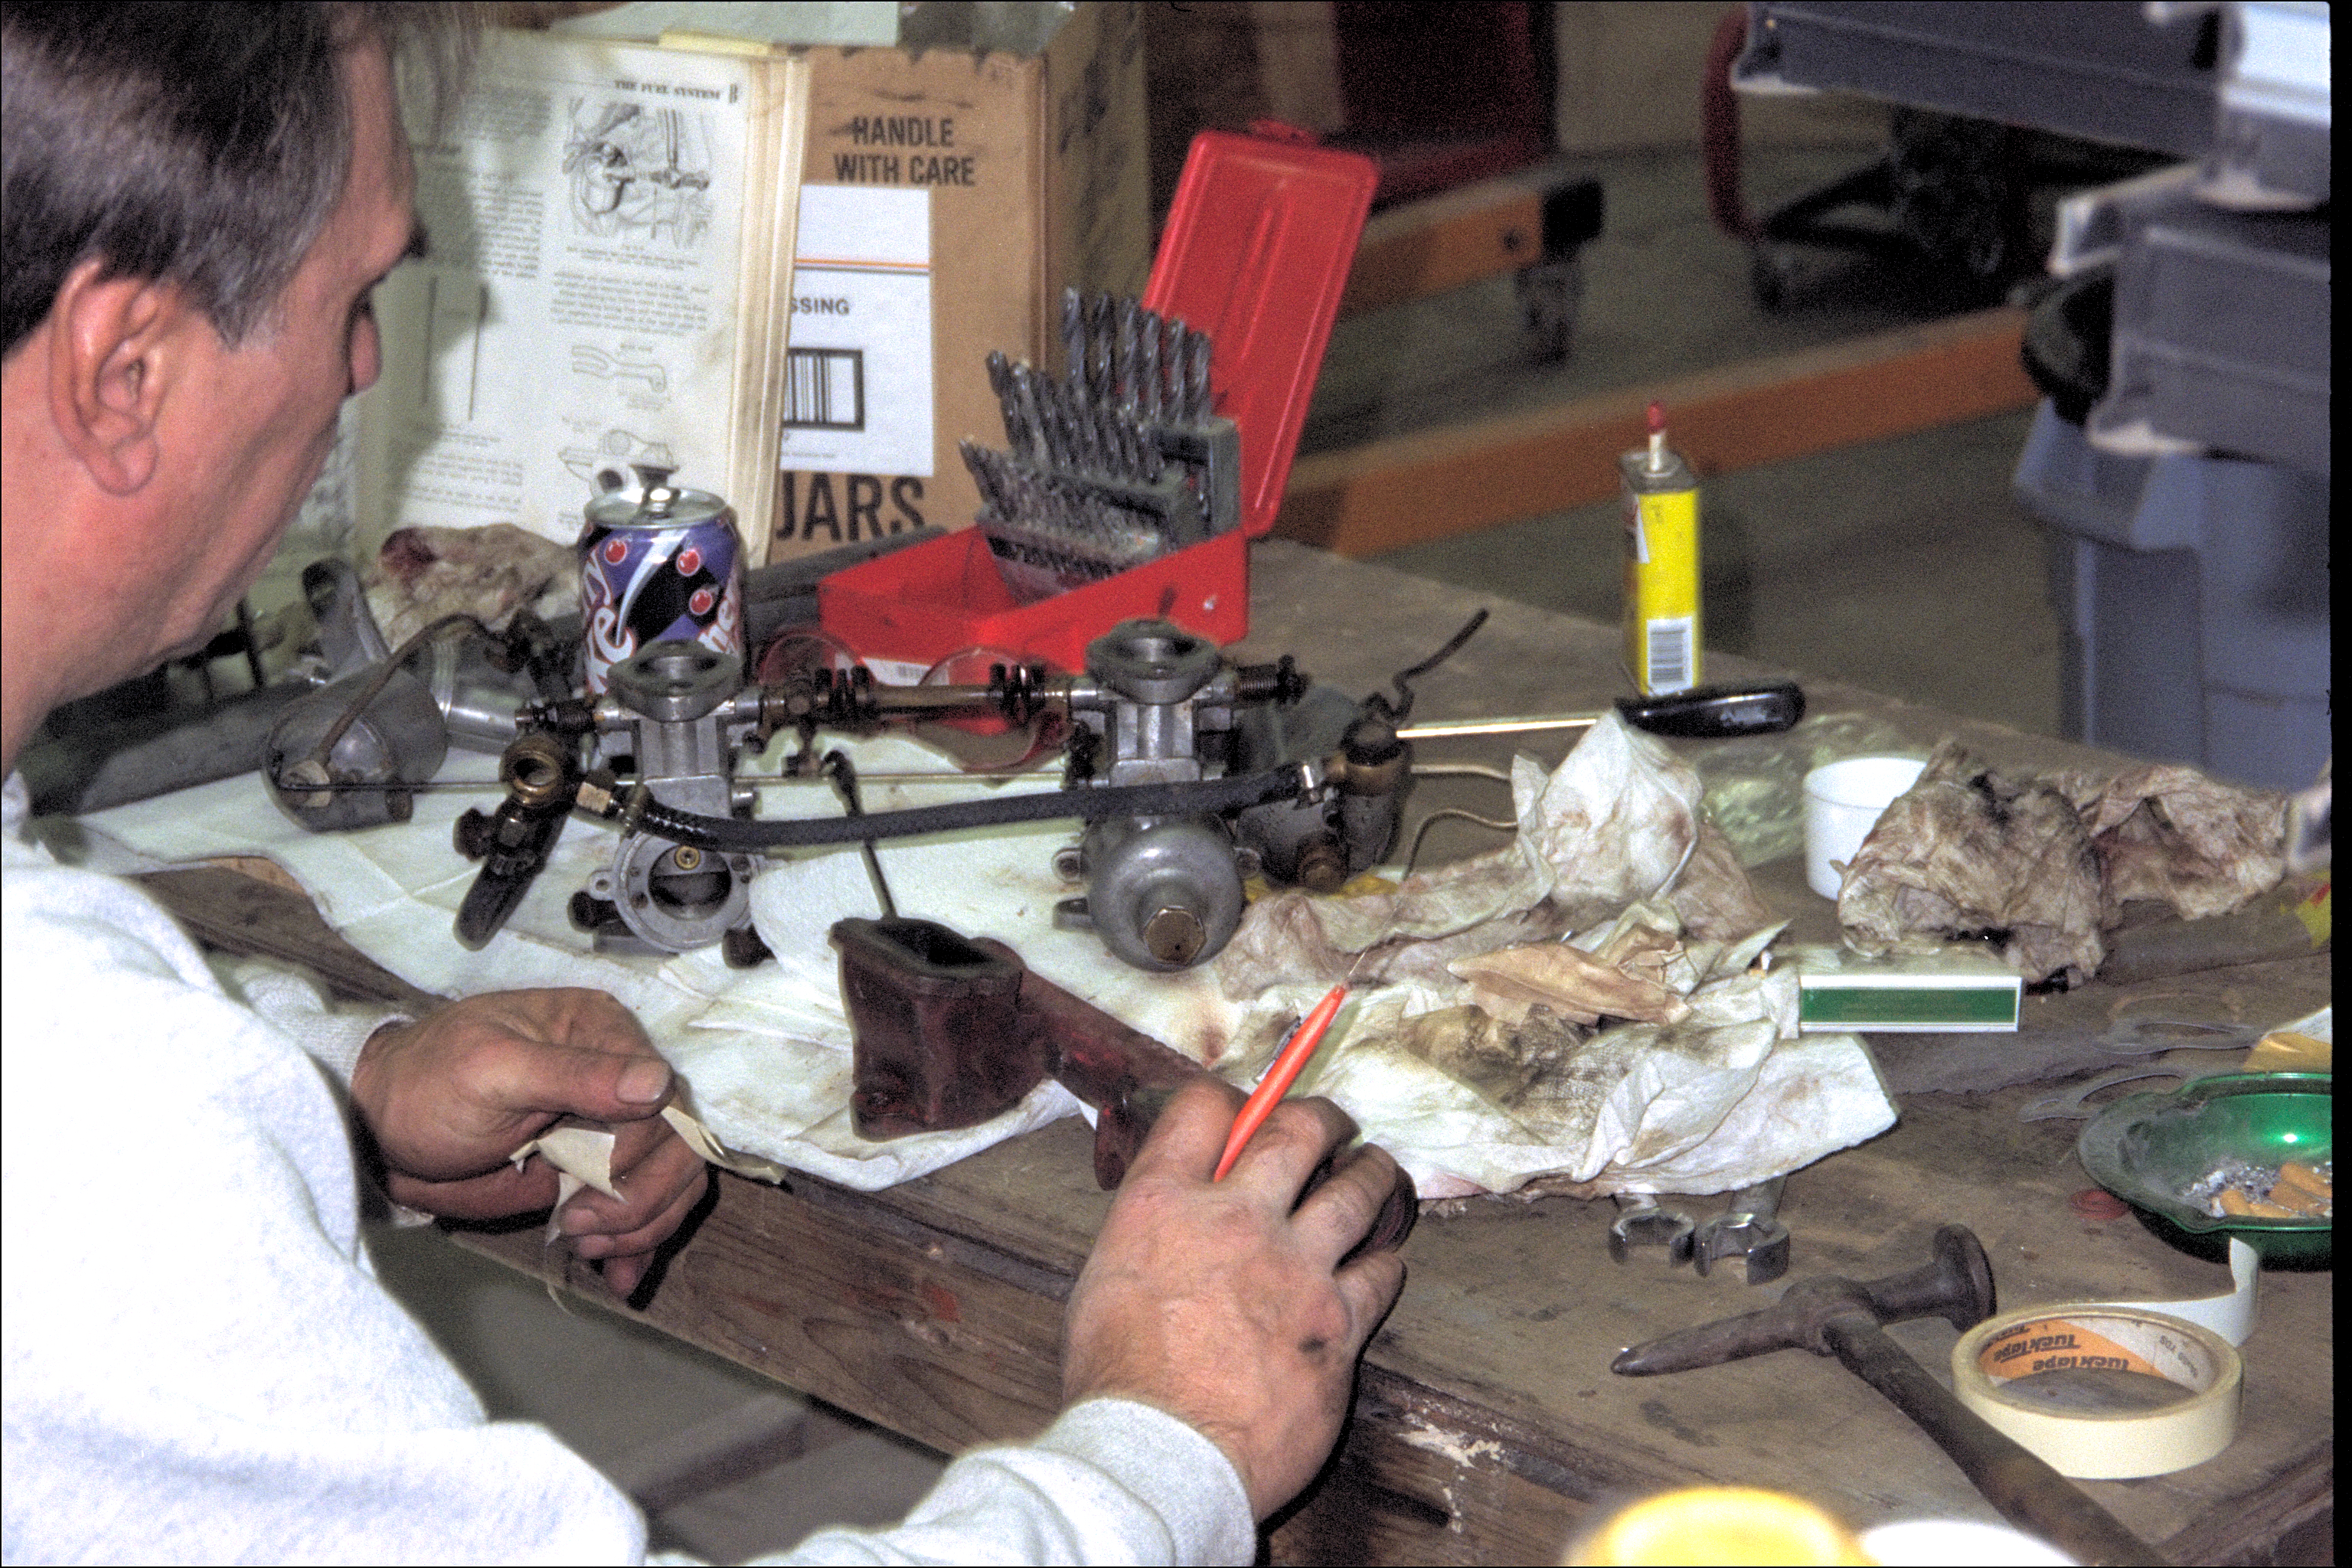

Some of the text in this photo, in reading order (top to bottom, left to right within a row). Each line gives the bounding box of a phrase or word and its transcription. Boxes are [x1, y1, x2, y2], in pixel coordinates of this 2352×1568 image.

[614, 80, 638, 91] THE
[673, 87, 720, 100] SYSTEM
[851, 116, 954, 147] HANDLE
[833, 154, 975, 186] WITH CARE
[775, 471, 925, 542] JARS
